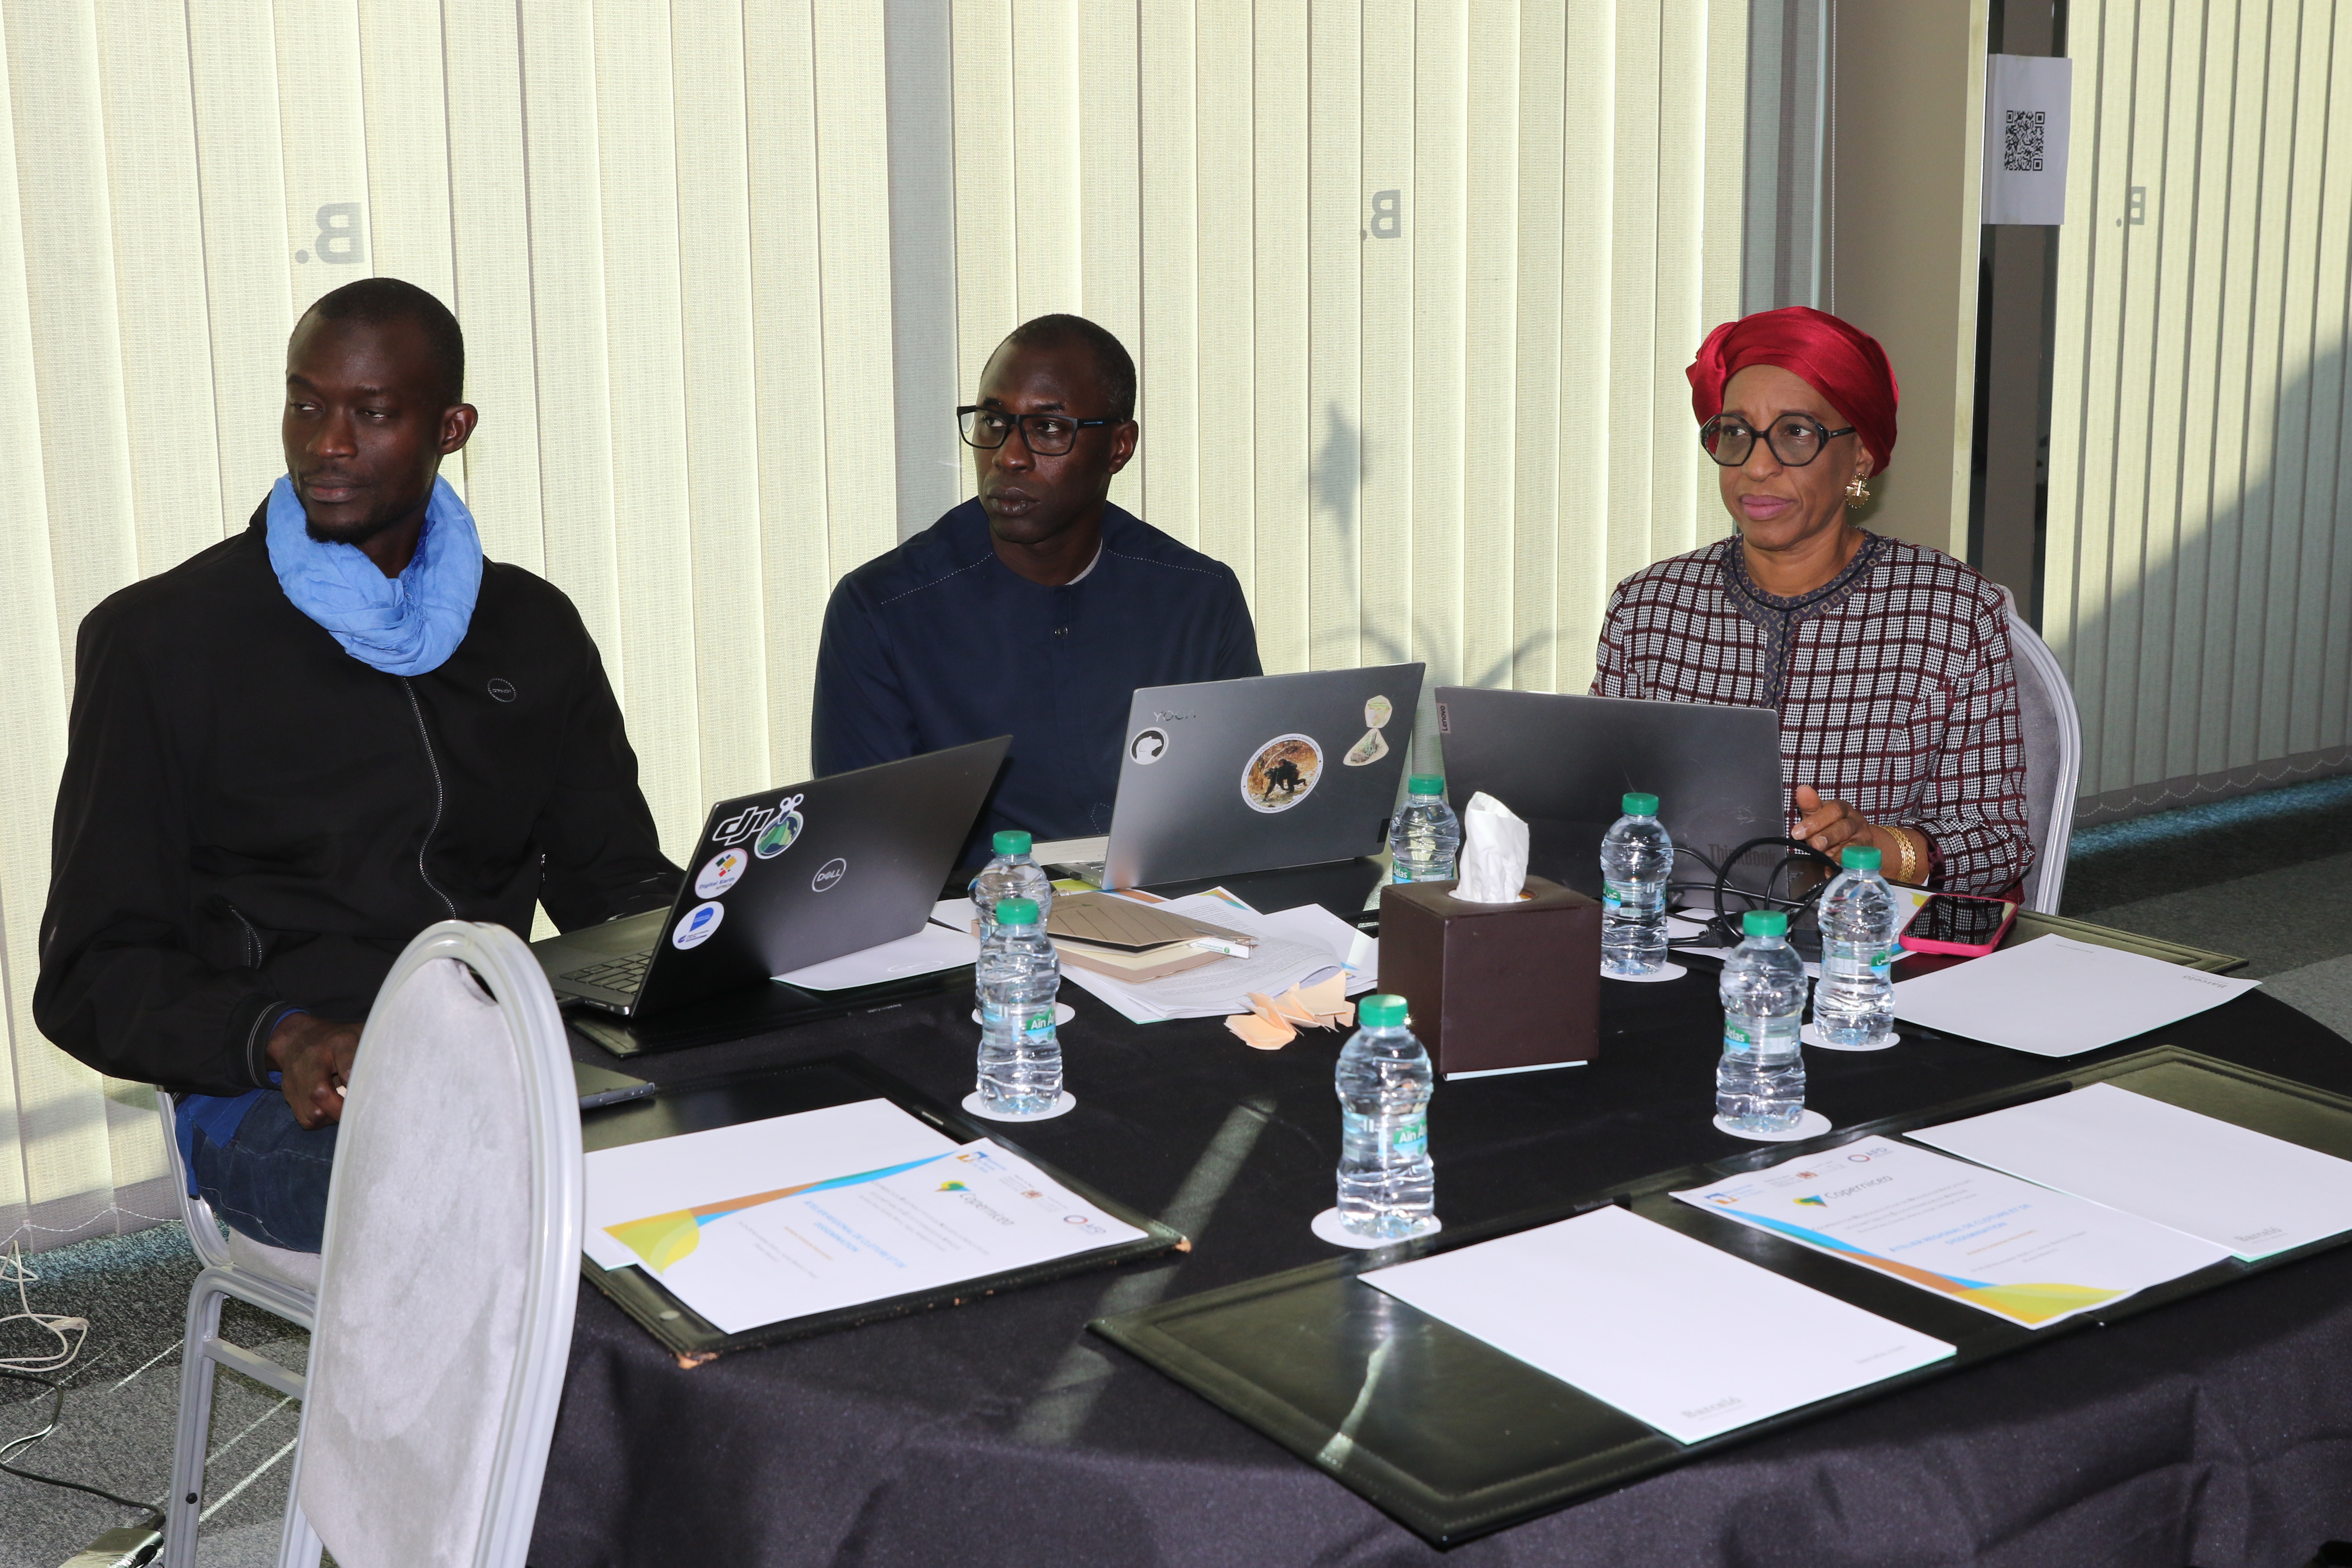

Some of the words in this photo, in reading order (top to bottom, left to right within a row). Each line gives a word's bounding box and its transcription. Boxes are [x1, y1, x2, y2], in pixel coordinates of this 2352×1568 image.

[817, 869, 840, 882] DELL
[1393, 865, 1408, 879] Atlas
[698, 880, 718, 890] Digital
[719, 877, 735, 885] Earth
[715, 882, 732, 891] AFRICA
[2183, 974, 2229, 989] Barceló
[1031, 1017, 1046, 1030] Aïn
[1725, 1026, 1745, 1042] Atlas
[1824, 1175, 1893, 1200] Copernicea
